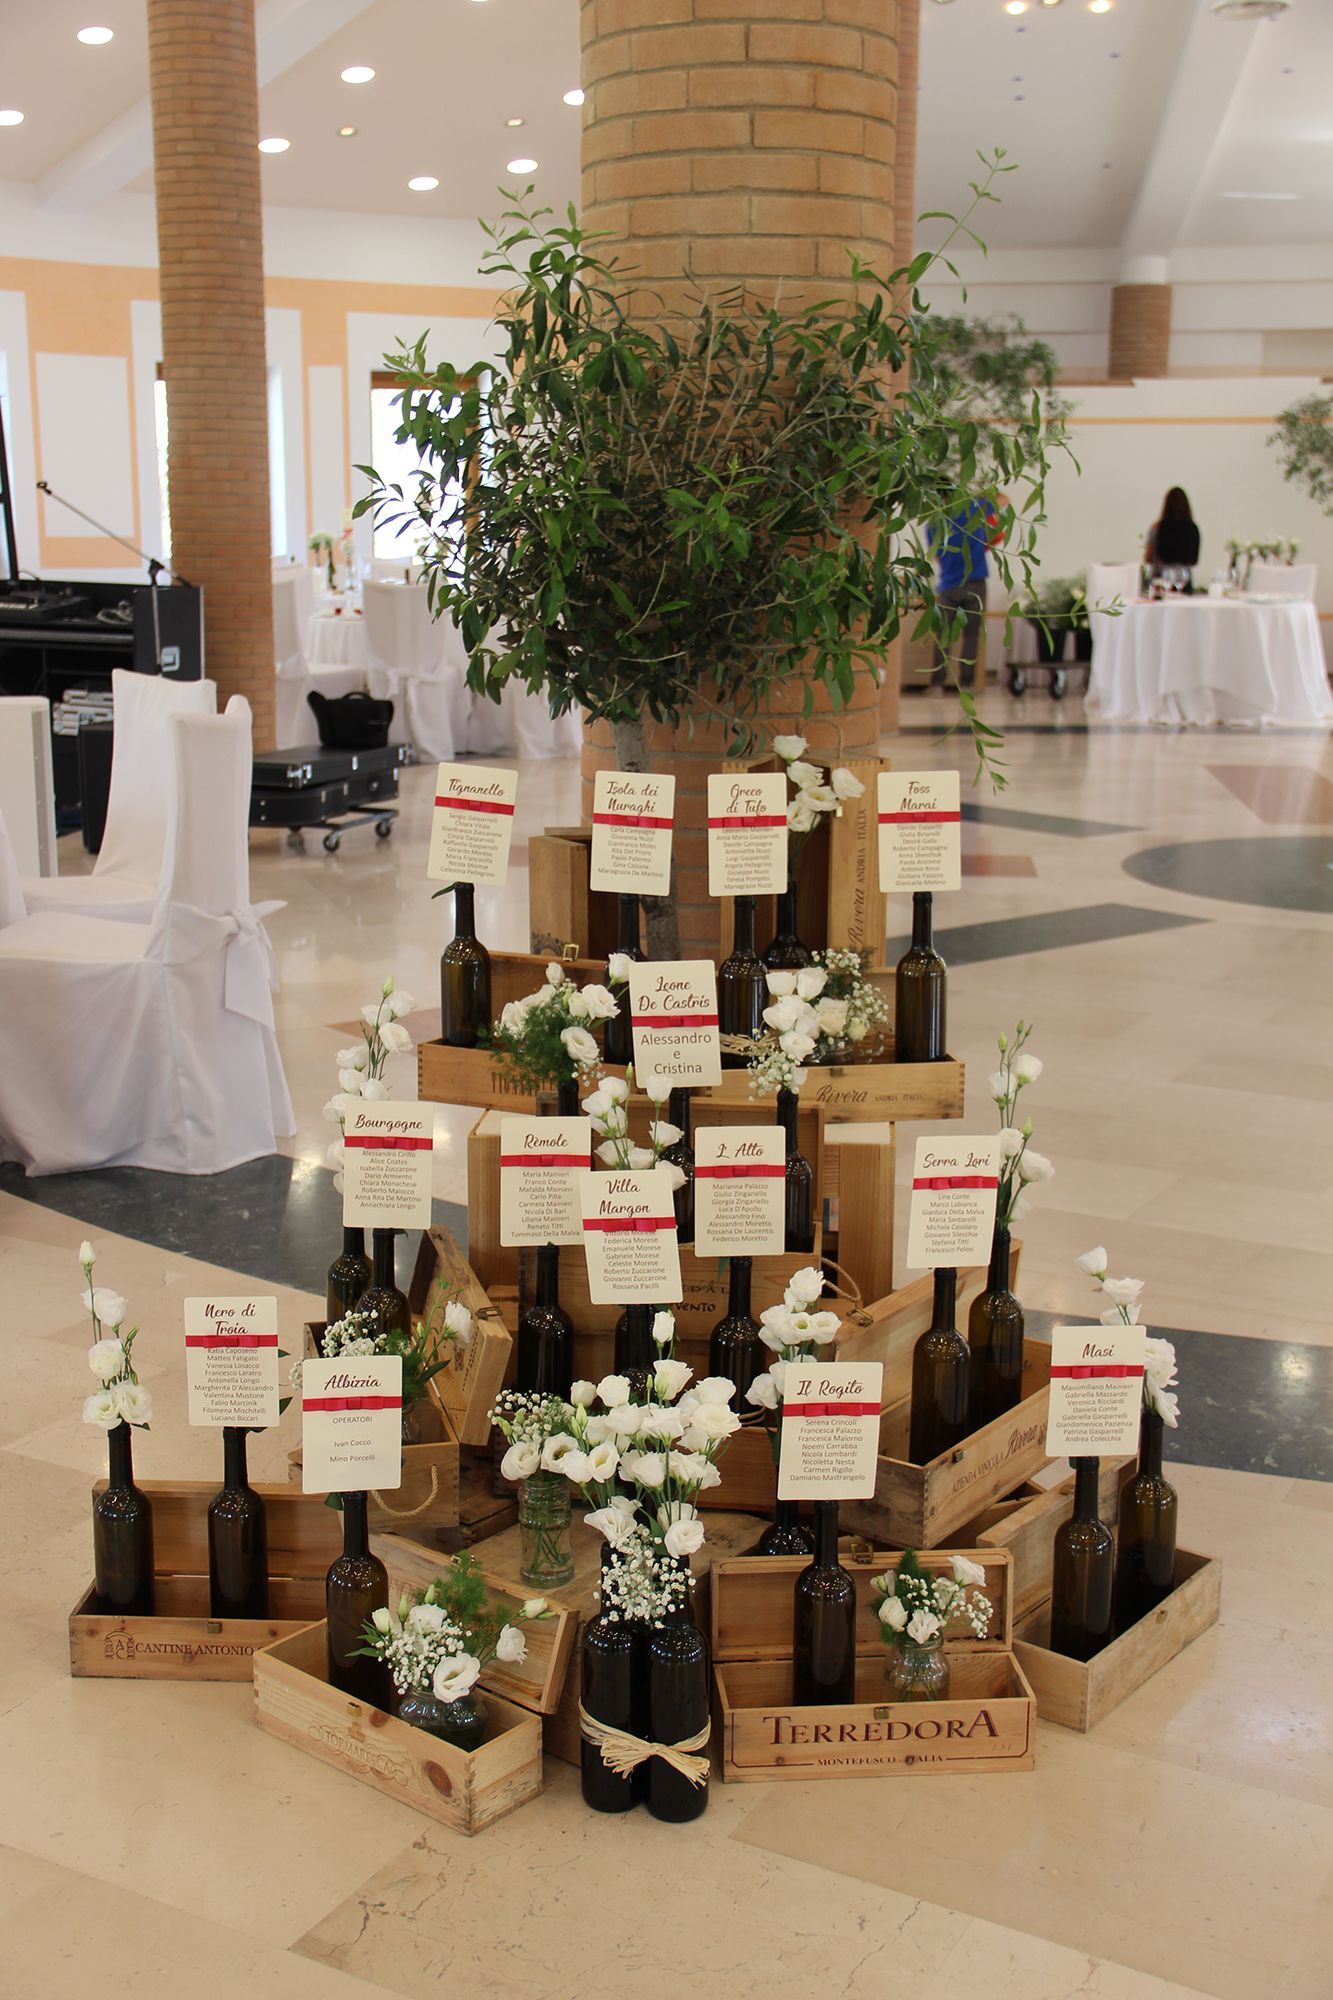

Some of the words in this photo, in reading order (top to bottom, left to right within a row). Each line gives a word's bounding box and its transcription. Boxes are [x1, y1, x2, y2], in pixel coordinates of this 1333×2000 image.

[449, 778, 505, 797] Tignanello
[606, 781, 636, 795] Isola
[641, 784, 659, 797] dei
[730, 784, 762, 798] Greco
[908, 781, 930, 795] Toss
[608, 798, 656, 815] Nuraghi
[727, 800, 738, 813] di
[745, 800, 766, 816] Tufo
[900, 798, 937, 811] Marai
[857, 809, 867, 840] ITALIA
[856, 848, 867, 883] ANDRIA
[848, 888, 865, 945] Rivera
[656, 976, 691, 992] Leone
[639, 995, 657, 1011] De
[664, 994, 710, 1010] Castris
[641, 1033, 711, 1045] Alessandro
[674, 1051, 680, 1059] e
[654, 1063, 702, 1074] Cristina
[816, 1084, 868, 1104] Rivera
[355, 1114, 423, 1133] Bourgogne
[735, 1142, 764, 1158] Alto
[923, 1153, 958, 1168] Serra
[965, 1152, 990, 1168] Lori
[606, 1179, 640, 1194] Villa
[600, 1200, 650, 1217] Margon
[205, 1304, 236, 1318] Nero
[242, 1303, 255, 1317] di
[216, 1321, 248, 1335] Troia
[1082, 1344, 1114, 1358] Masi
[324, 1374, 381, 1390] Albizzia
[797, 1380, 812, 1397] Il
[819, 1380, 863, 1398] Rogito
[1005, 1425, 1037, 1459] Rivera
[136, 1643, 193, 1655] CANTINE
[196, 1644, 254, 1656] ANTONIO
[762, 1709, 1000, 1745] TERREDORA
[324, 1730, 390, 1775] TORMARESCA
[817, 1756, 896, 1766] MONTEFUSCO
